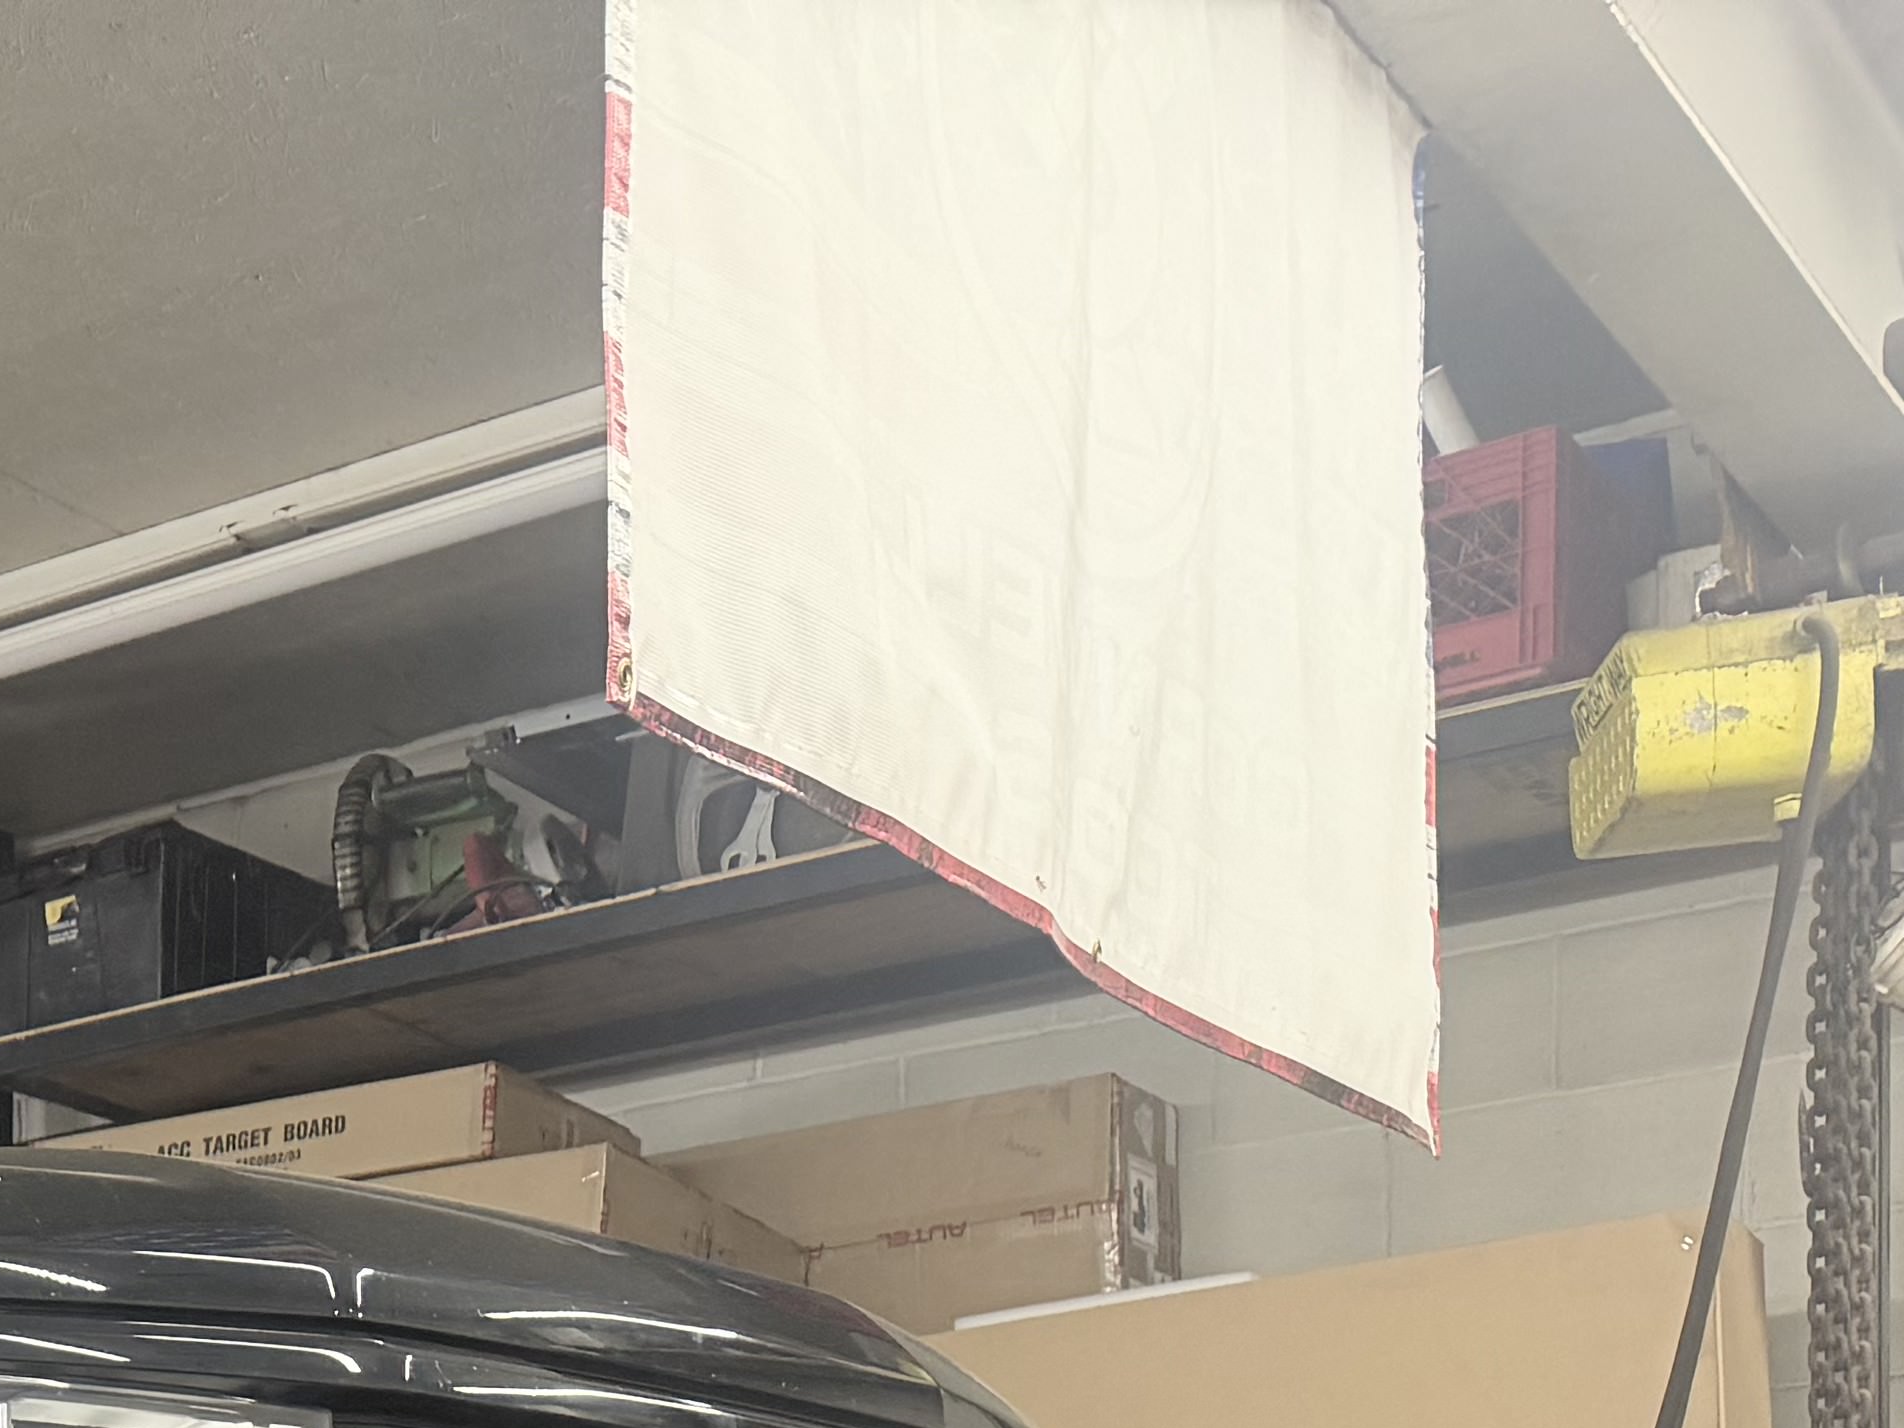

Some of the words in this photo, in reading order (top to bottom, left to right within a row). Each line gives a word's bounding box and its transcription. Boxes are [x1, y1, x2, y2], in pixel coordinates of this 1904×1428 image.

[202, 1126, 272, 1157] TARGET
[283, 1113, 347, 1142] BOARD
[876, 1220, 968, 1250] AUTEL
